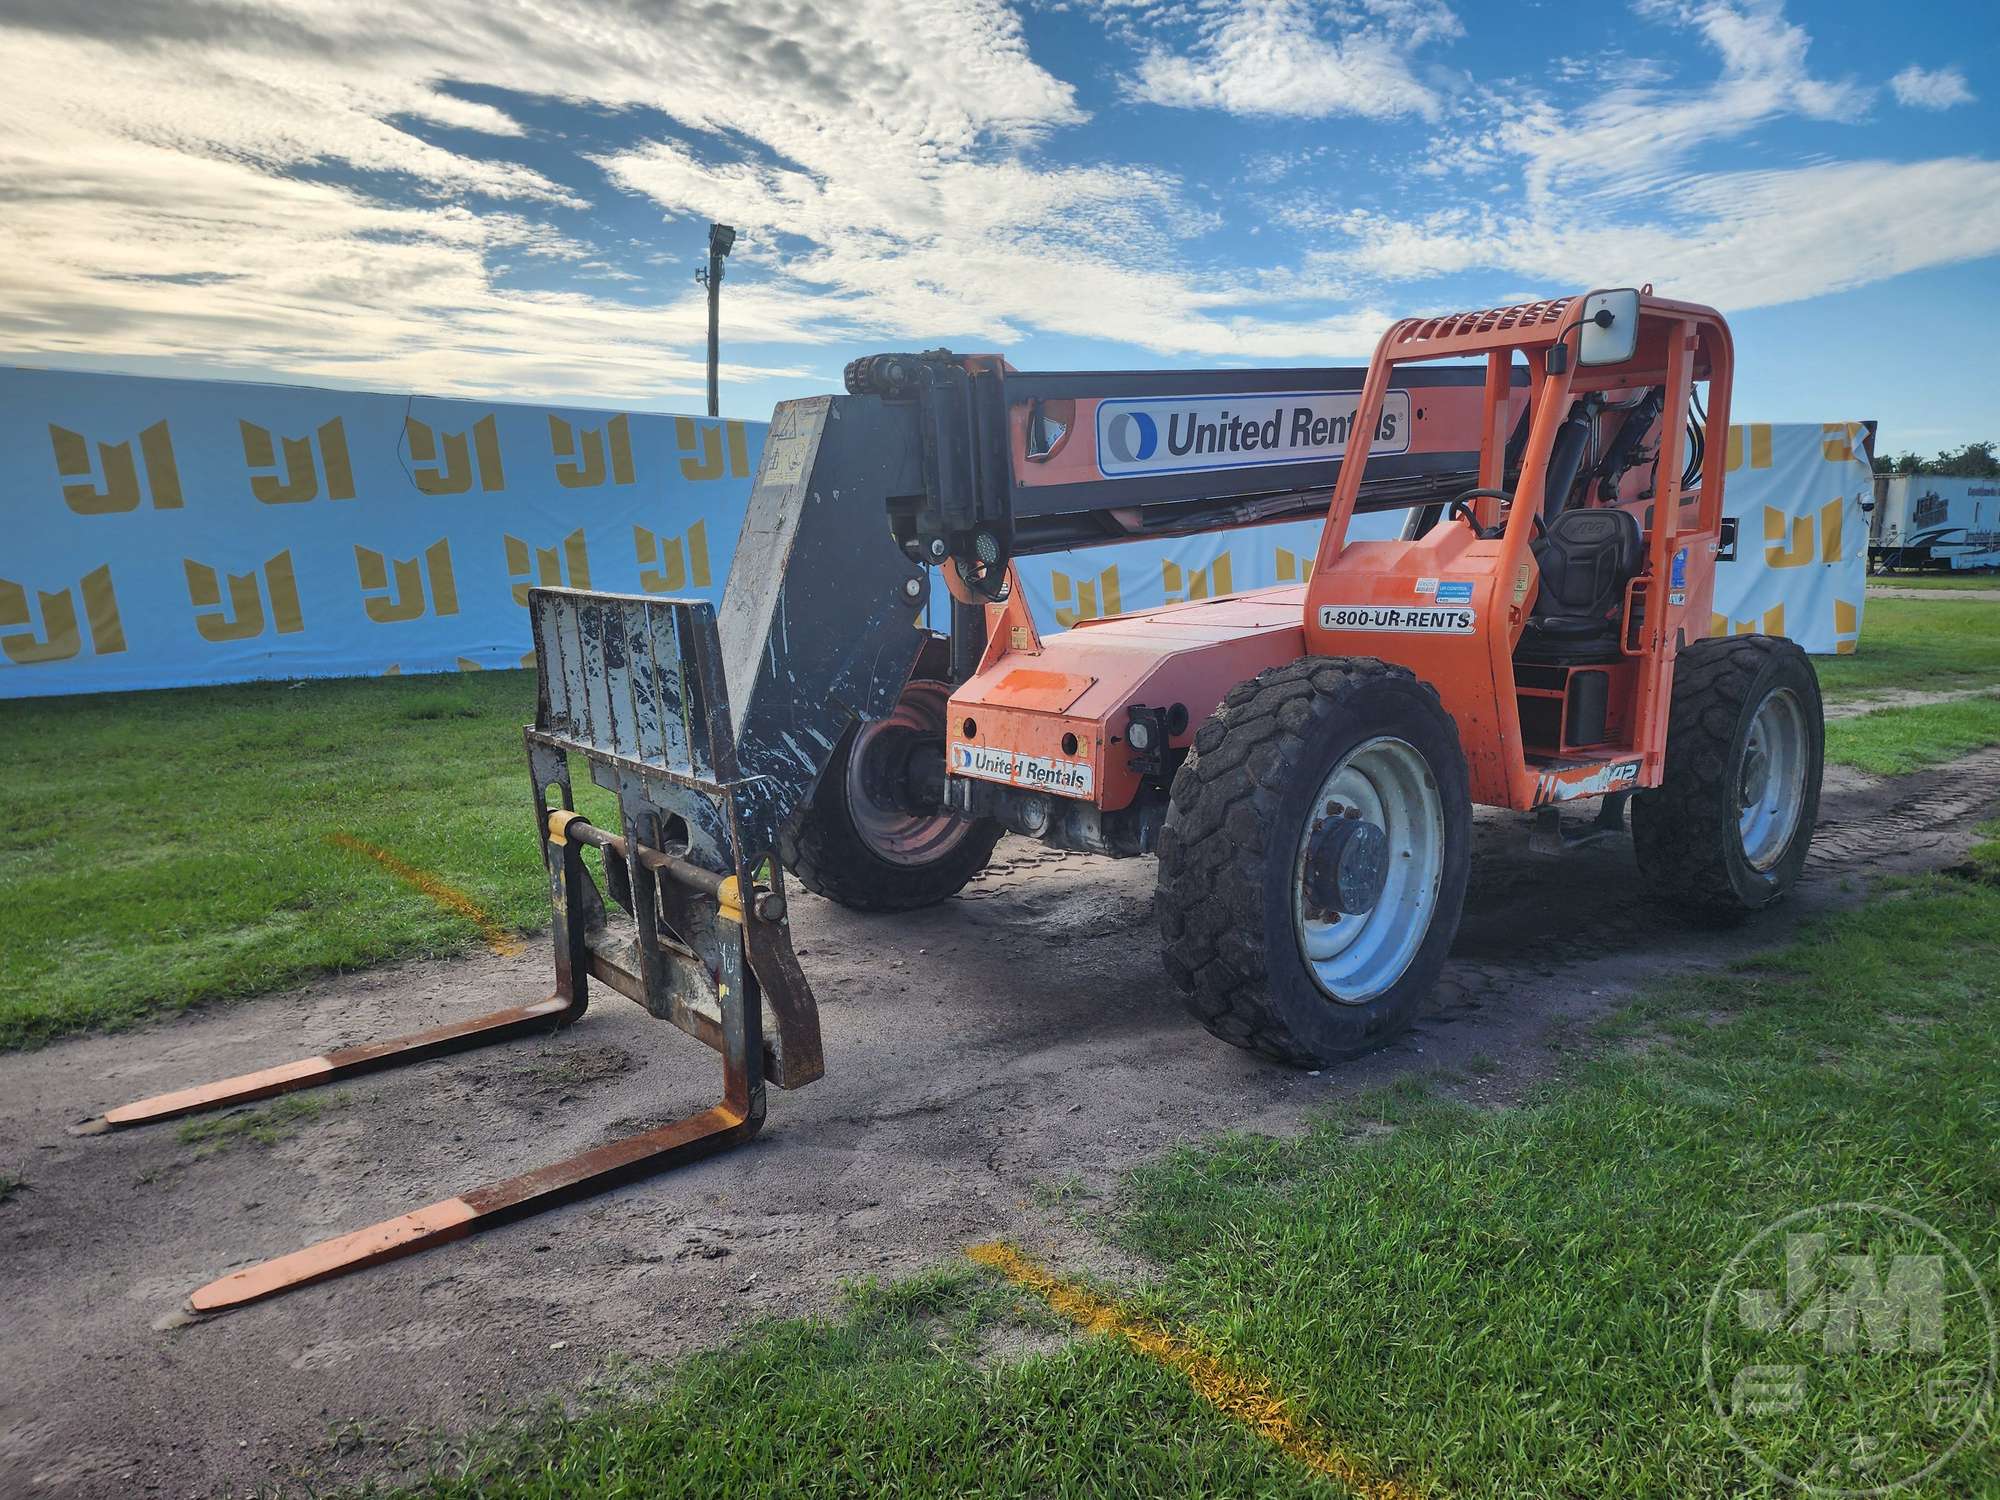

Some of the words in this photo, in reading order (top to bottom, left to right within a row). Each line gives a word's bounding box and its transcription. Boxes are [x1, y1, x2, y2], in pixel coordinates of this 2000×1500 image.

[1167, 408, 1284, 456] United
[1290, 403, 1397, 447] Renls
[1323, 609, 1471, 628] 1-800-UR-RENTS
[975, 752, 1023, 777] United
[1026, 761, 1085, 789] Rentals
